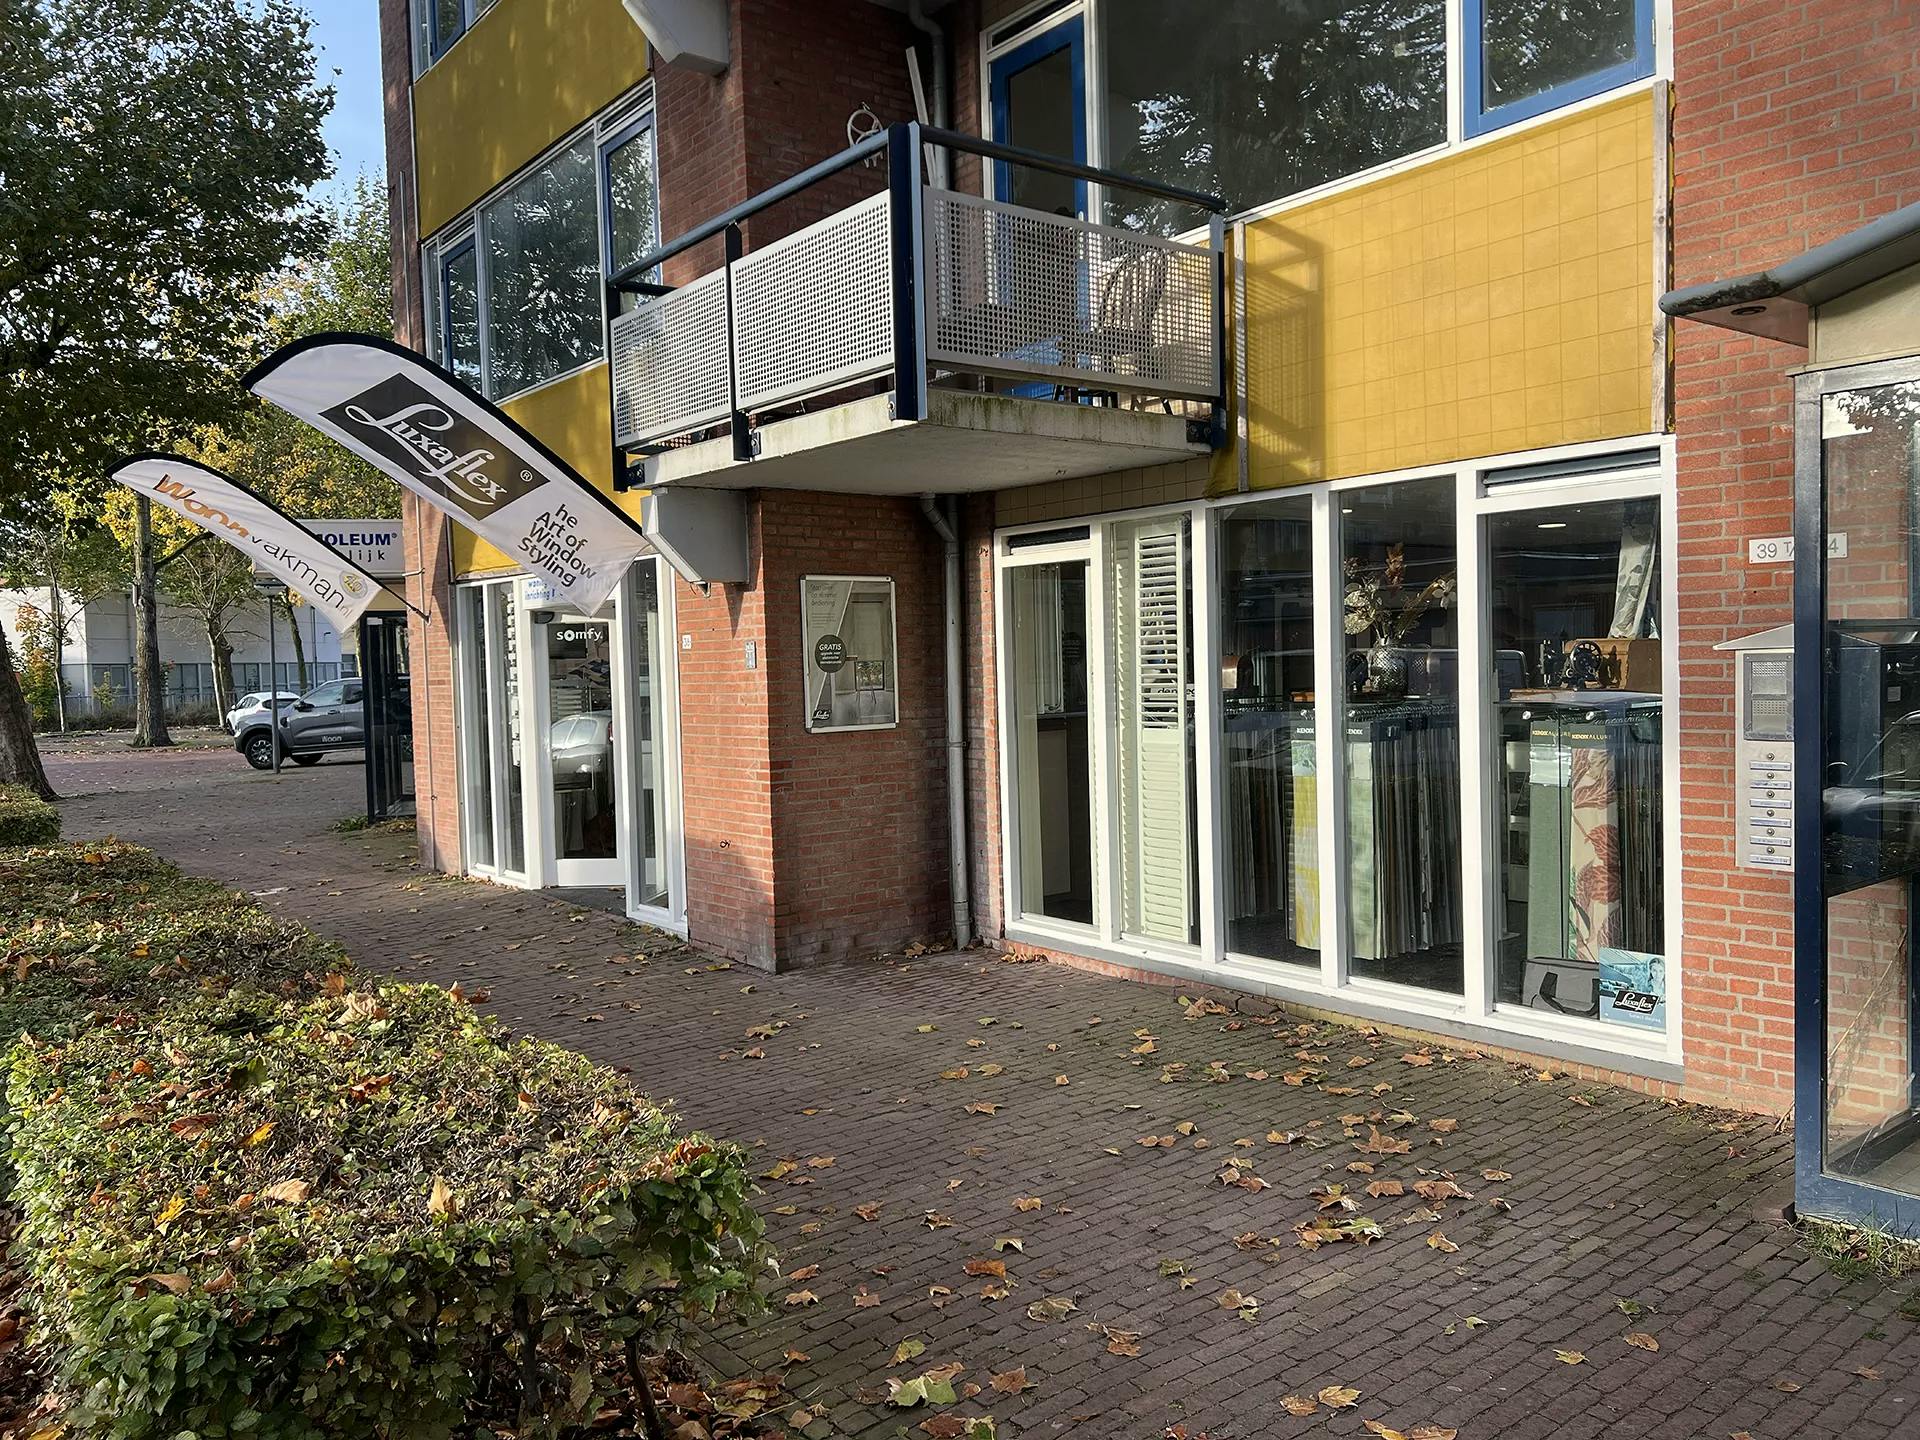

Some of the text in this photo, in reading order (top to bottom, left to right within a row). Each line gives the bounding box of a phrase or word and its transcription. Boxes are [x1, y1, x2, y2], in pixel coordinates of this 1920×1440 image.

[344, 402, 507, 506] Luxaflex
[529, 521, 597, 579] Window
[535, 511, 588, 552] Art of
[1756, 543, 1777, 559] 39
[519, 536, 577, 588] Styling
[818, 643, 842, 651] GRATIS
[1614, 992, 1654, 1012] Luxaflex
